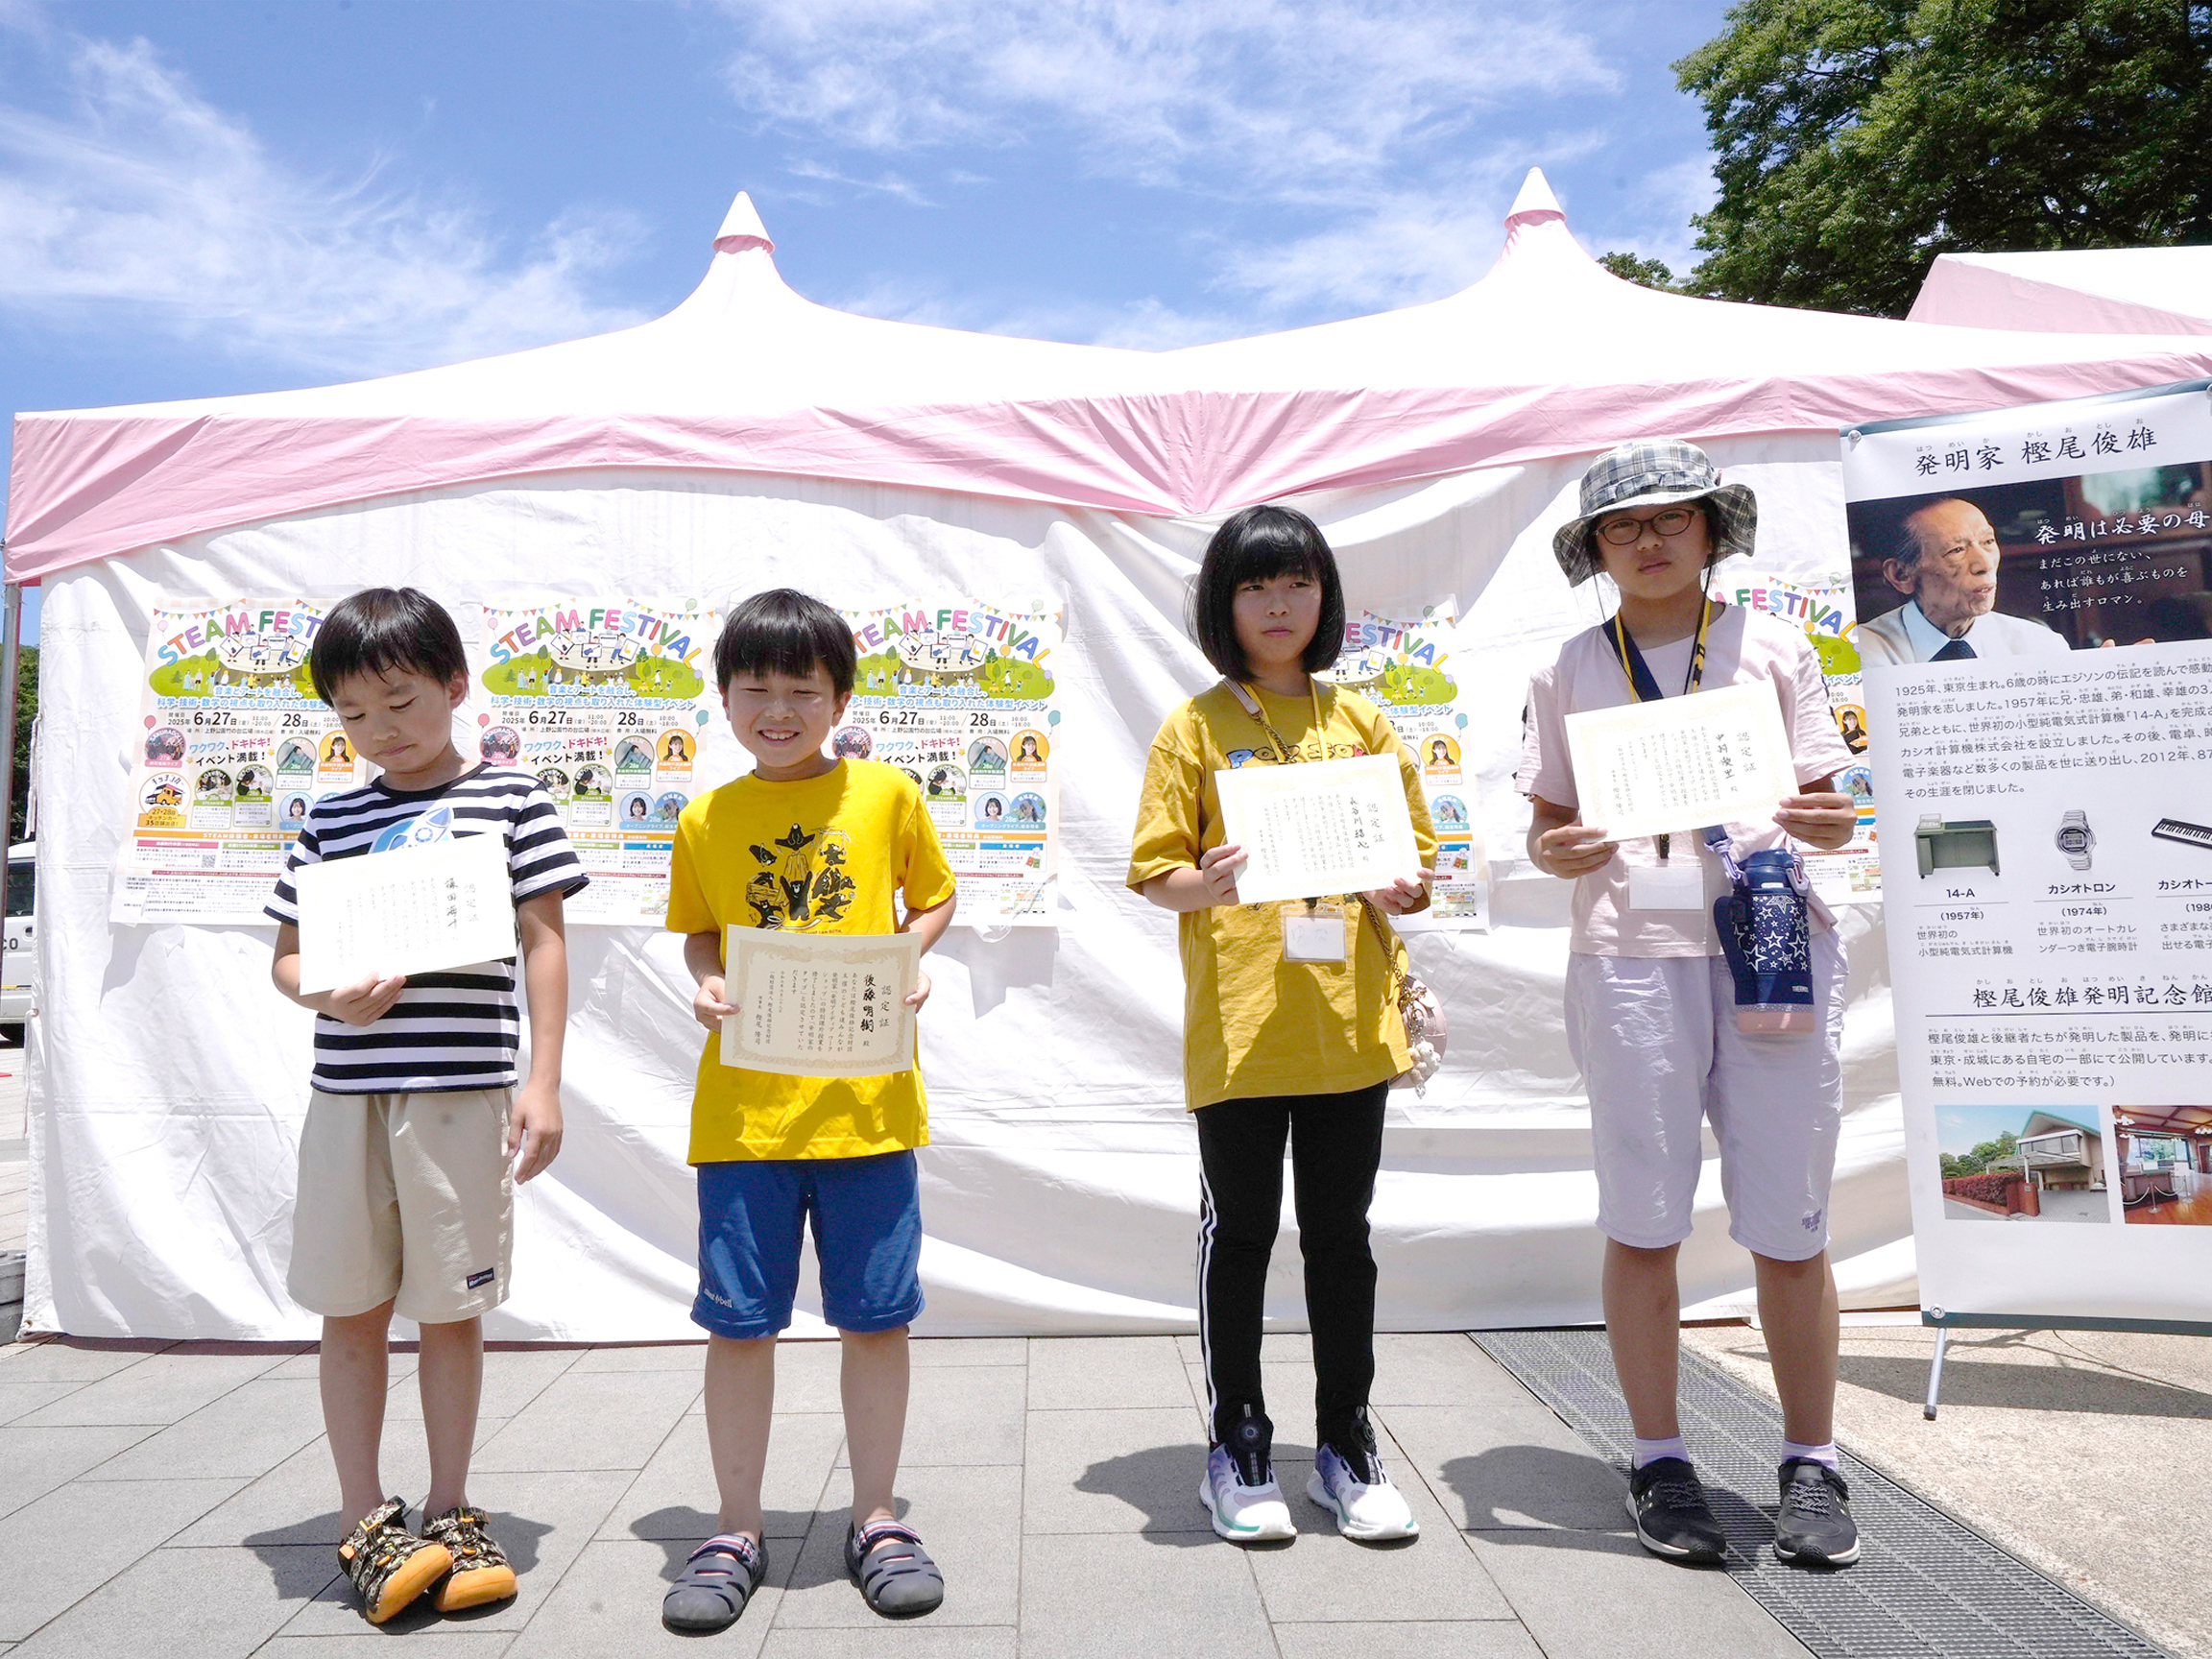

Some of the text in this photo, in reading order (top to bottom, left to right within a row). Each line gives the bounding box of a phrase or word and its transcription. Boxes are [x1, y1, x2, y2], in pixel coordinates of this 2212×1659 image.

[1914, 426, 2158, 477] 発明家 樫尾俊雄
[2034, 510, 2211, 545] 発明は必要の母
[2039, 550, 2152, 570] まだこの世にない、
[2040, 566, 2188, 590] あれば誰もが喜ぶものを
[2042, 594, 2142, 613] 生み出すロマン。
[1736, 588, 1857, 643] FESTIVAL
[157, 612, 251, 666] STEAM
[490, 609, 702, 669] STEAM FESTIVAL
[937, 610, 1050, 669] FESTIVAL
[1345, 622, 1449, 675] ESTIVAL
[214, 685, 303, 698] 音楽とアートを融合し、
[549, 685, 637, 696] 音楽とアートを融合し、
[899, 685, 988, 697] 音楽とアートを融合し、
[1897, 685, 2212, 718] 発明家を志しました。1957年に兄・忠雄、弟・和雄、幸雄の3
[189, 738, 271, 754] ワクワク、ドキドキ!
[523, 736, 607, 753] ワクワク、ドキドキ!
[876, 736, 960, 753] ワクワク、ドキドキ!
[195, 750, 266, 766] イベント満載!
[531, 749, 603, 765] イベント満載!
[1904, 783, 2025, 799] その生涯を閉じました。
[1366, 803, 1384, 843] 認定証
[1946, 888, 1976, 899] 14-A
[2048, 883, 2116, 895] カシオトロン
[1940, 911, 1984, 921] (1957年)
[2061, 906, 2107, 917] (1974年)
[1916, 929, 1958, 940] 世界初の
[2037, 925, 2137, 936] 世界初のオートカレ
[1973, 984, 2212, 1008] 樫尾俊雄発明記念館
[878, 984, 892, 1028] 認定証
